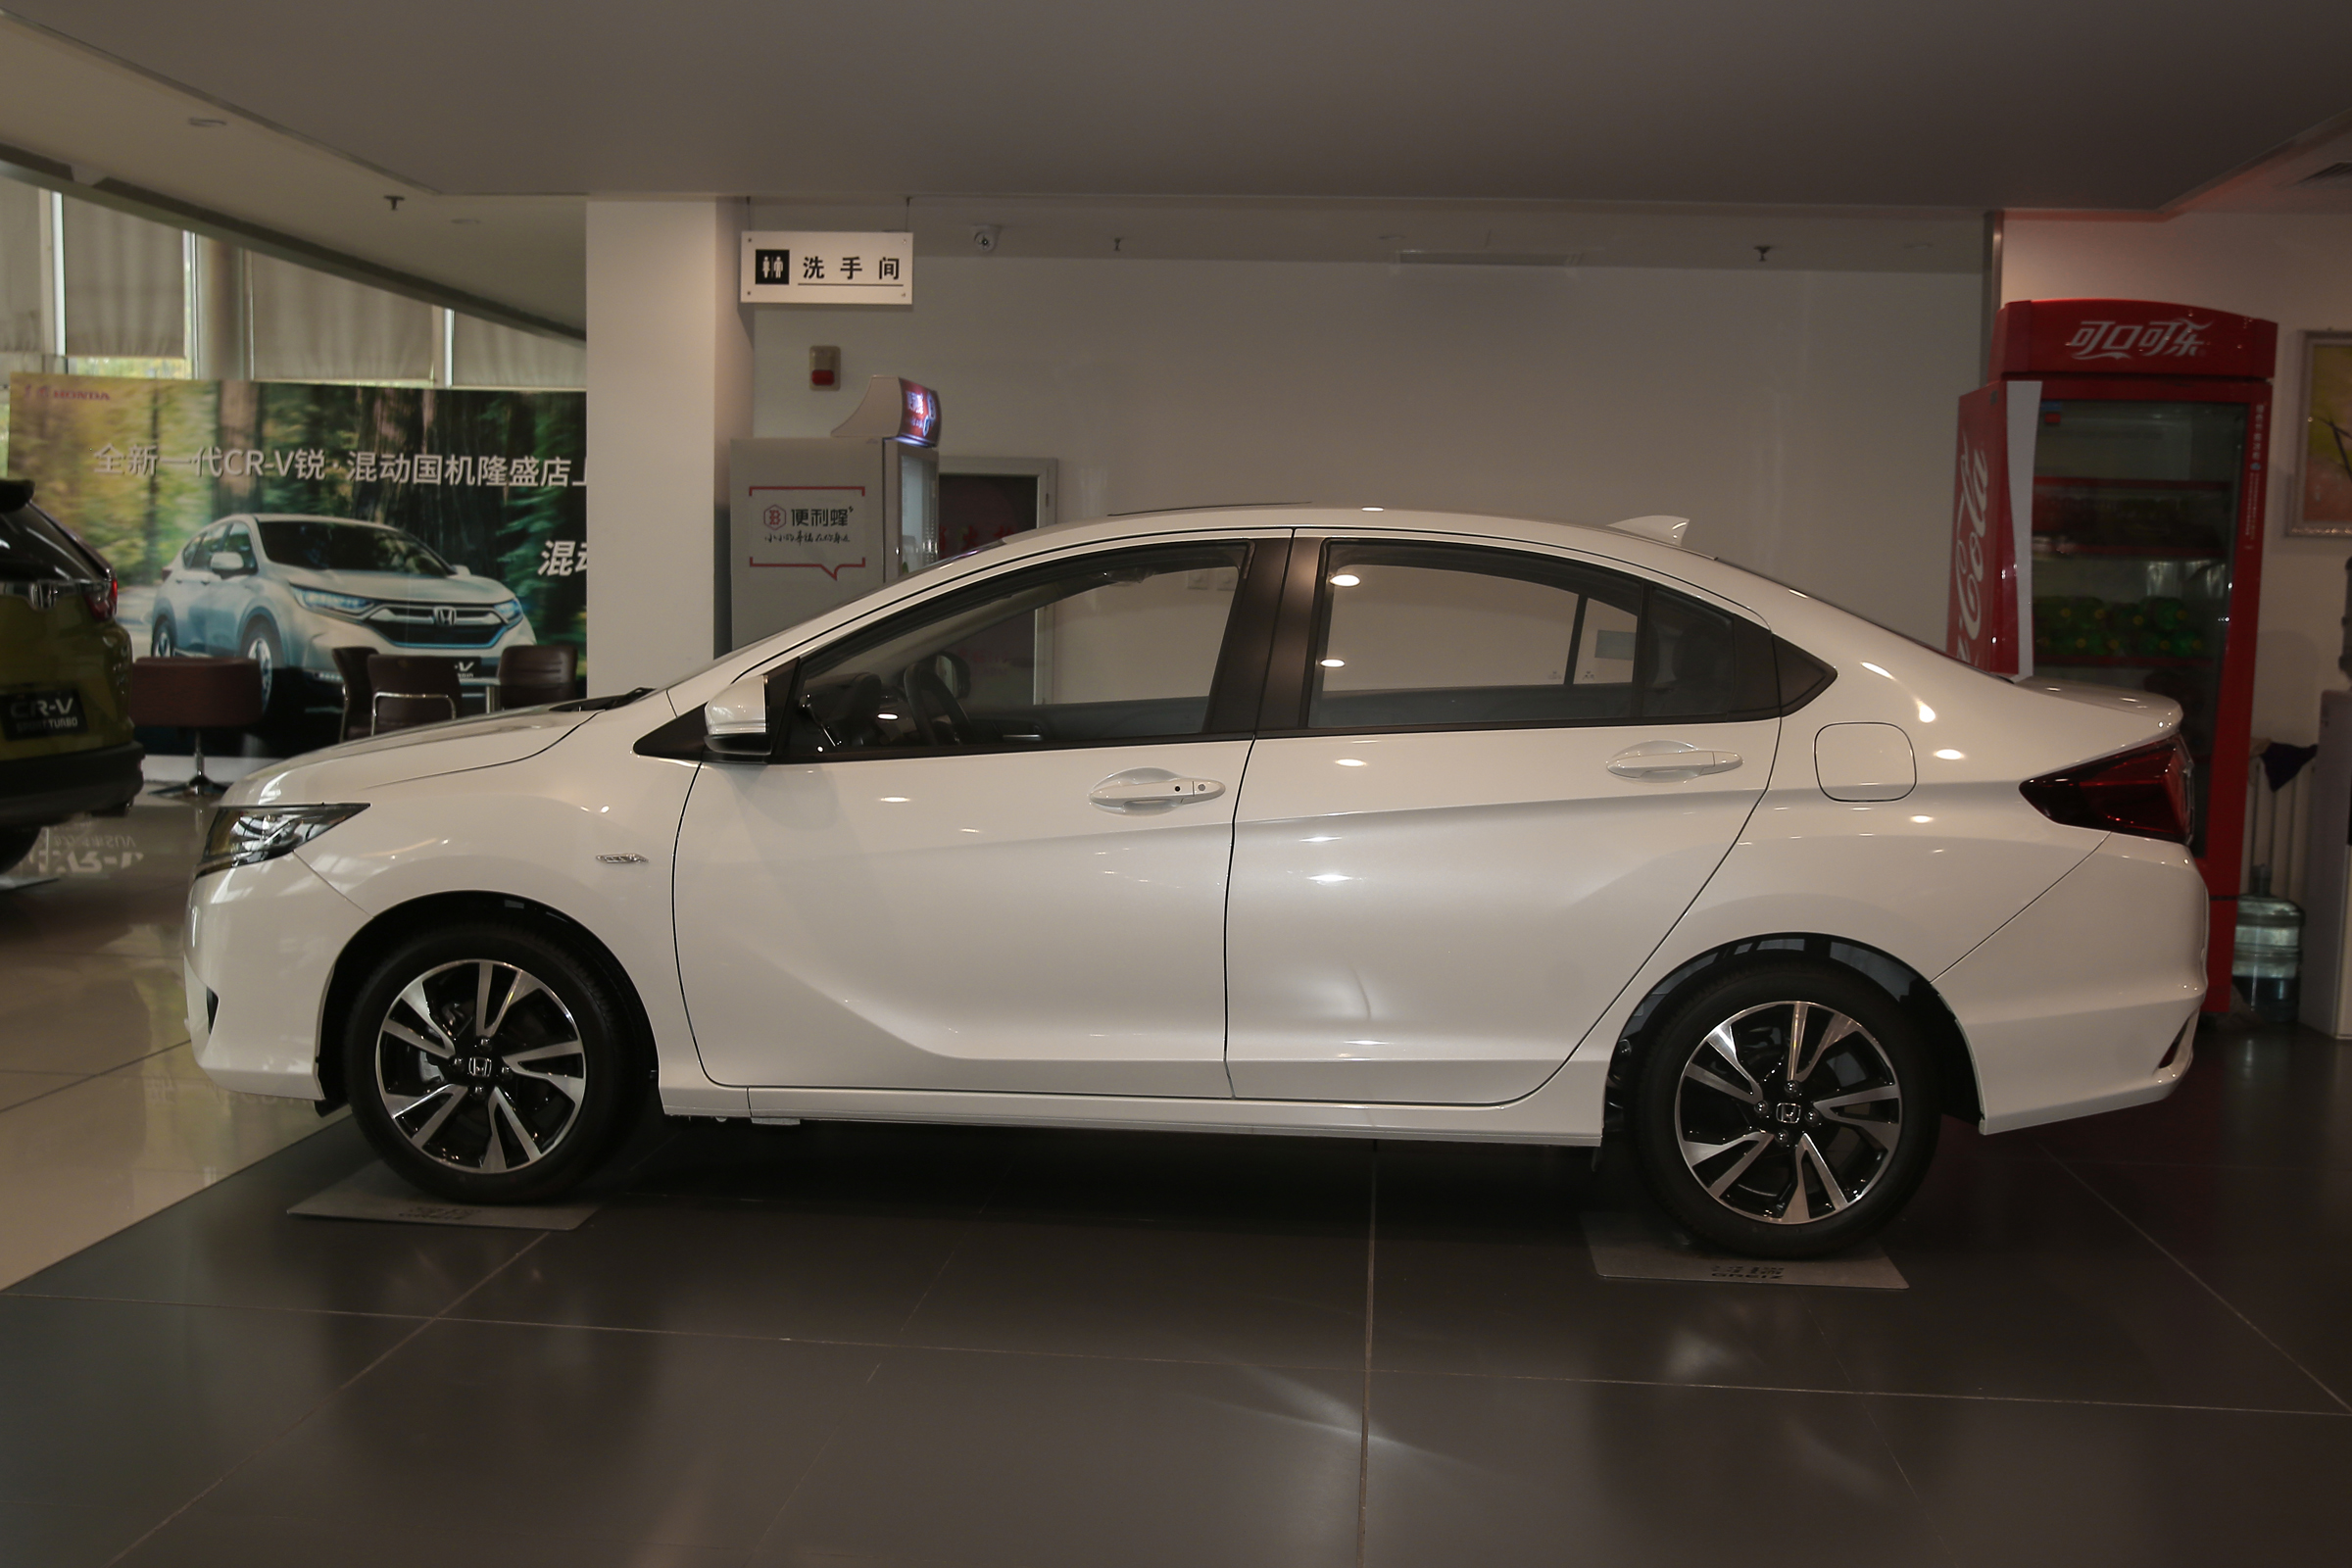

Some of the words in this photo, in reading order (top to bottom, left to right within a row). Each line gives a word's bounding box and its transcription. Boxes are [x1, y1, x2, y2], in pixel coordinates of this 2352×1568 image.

[803, 255, 900, 280] 洗手间
[2069, 318, 2213, 361] 可口可乐
[53, 390, 111, 401] HONDA
[791, 508, 850, 527] 便利蜂
[10, 697, 74, 718] CR-V
[48, 716, 78, 729] TURBO
